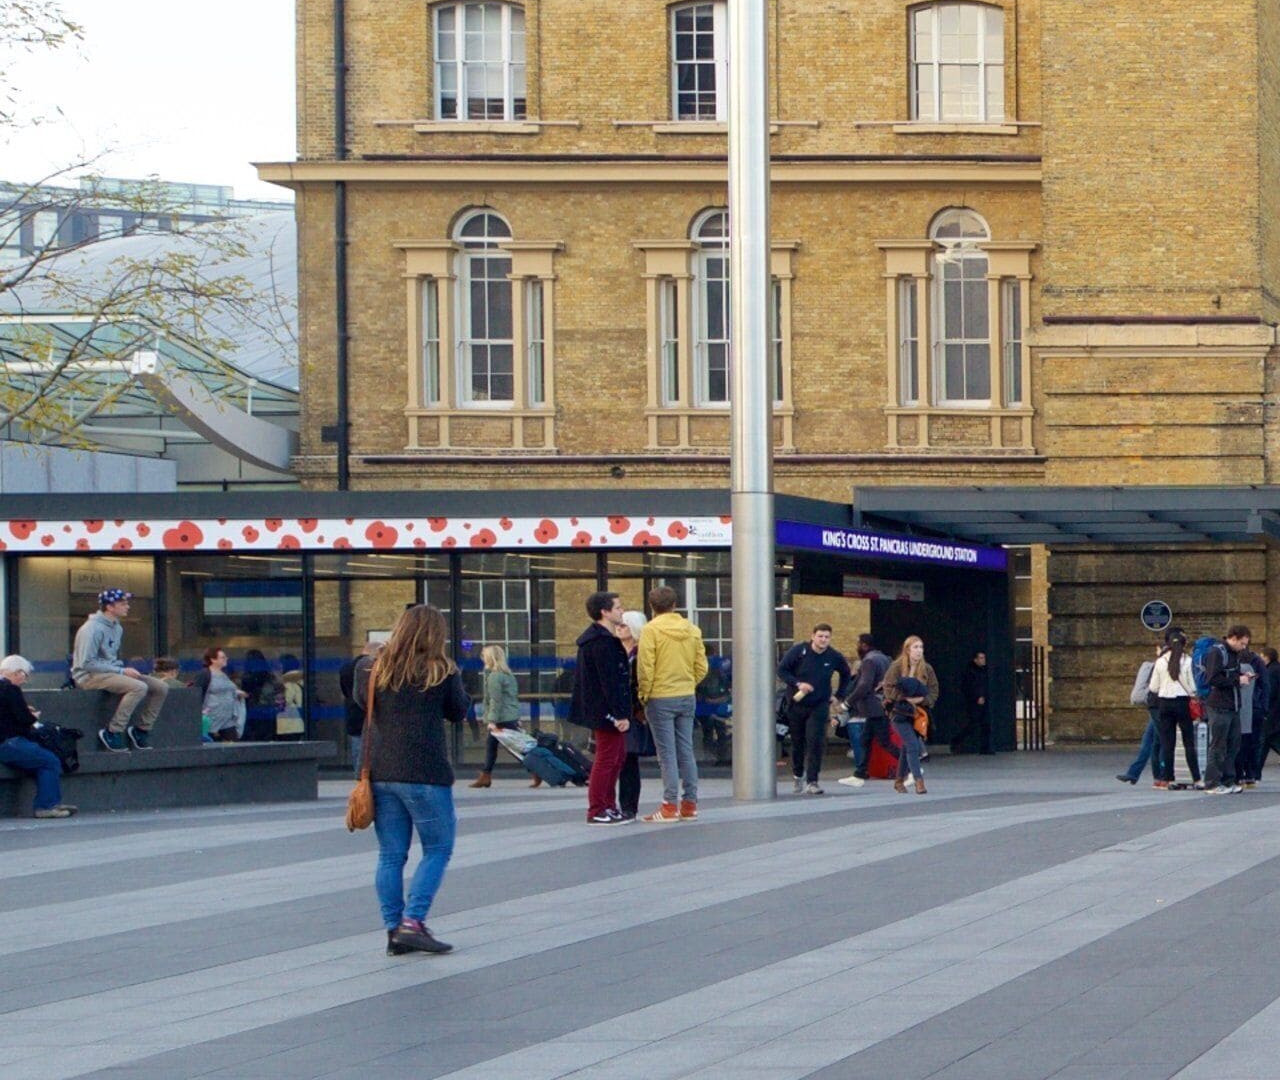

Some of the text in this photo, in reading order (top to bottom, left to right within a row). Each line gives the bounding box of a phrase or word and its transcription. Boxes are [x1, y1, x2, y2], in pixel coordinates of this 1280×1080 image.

[822, 530, 846, 548] KING'S
[847, 532, 869, 551] CROSS
[880, 538, 908, 555] PANCRAS
[909, 542, 954, 561] UNDERGROUND
[954, 547, 977, 563] STATION
